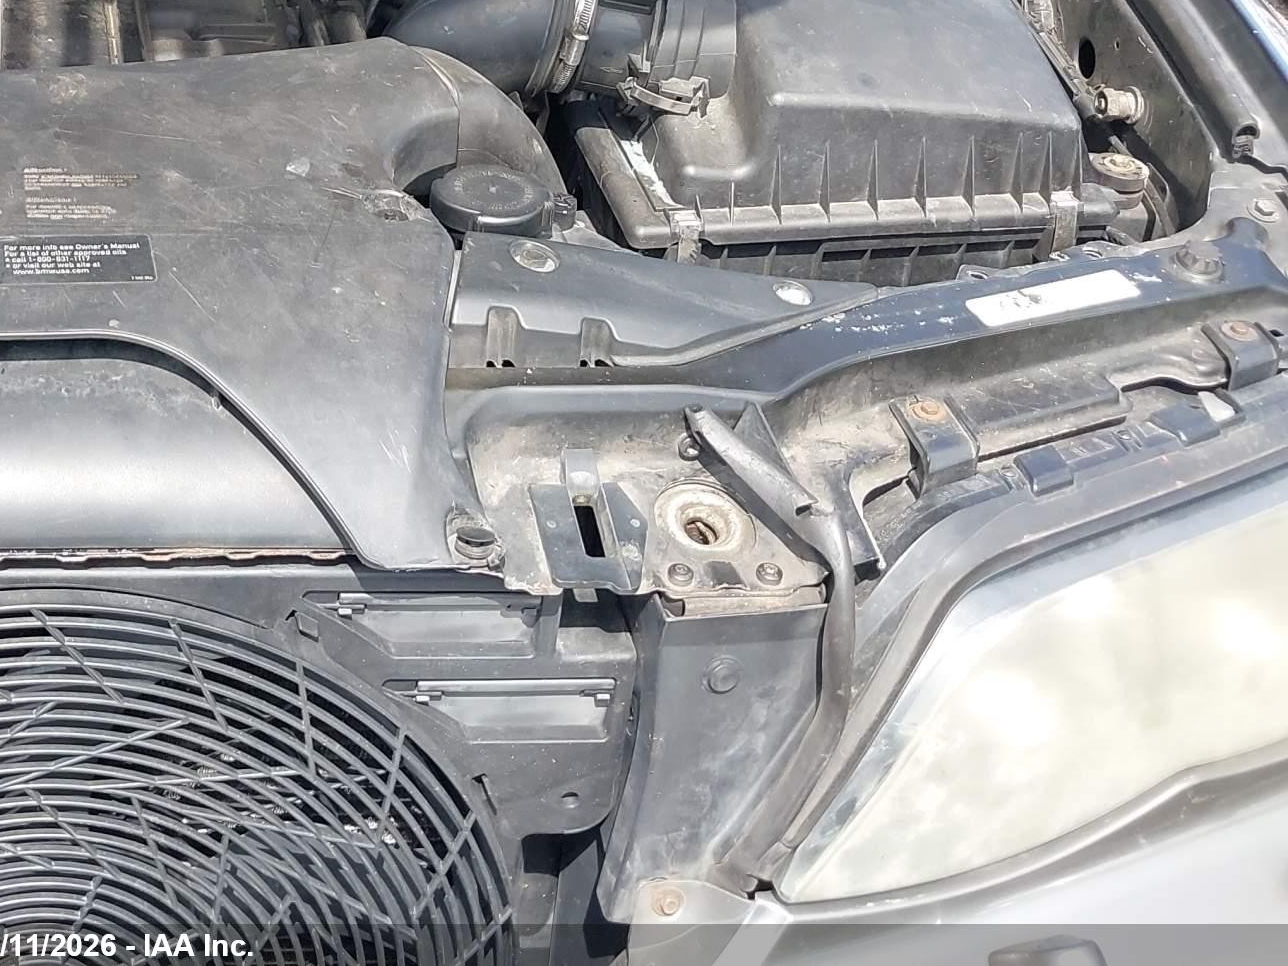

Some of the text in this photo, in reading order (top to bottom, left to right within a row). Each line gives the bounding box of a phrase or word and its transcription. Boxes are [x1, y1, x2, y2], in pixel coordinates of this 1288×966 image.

[75, 242, 108, 250] Owner's
[110, 242, 140, 250] Manual
[74, 249, 110, 257] approved
